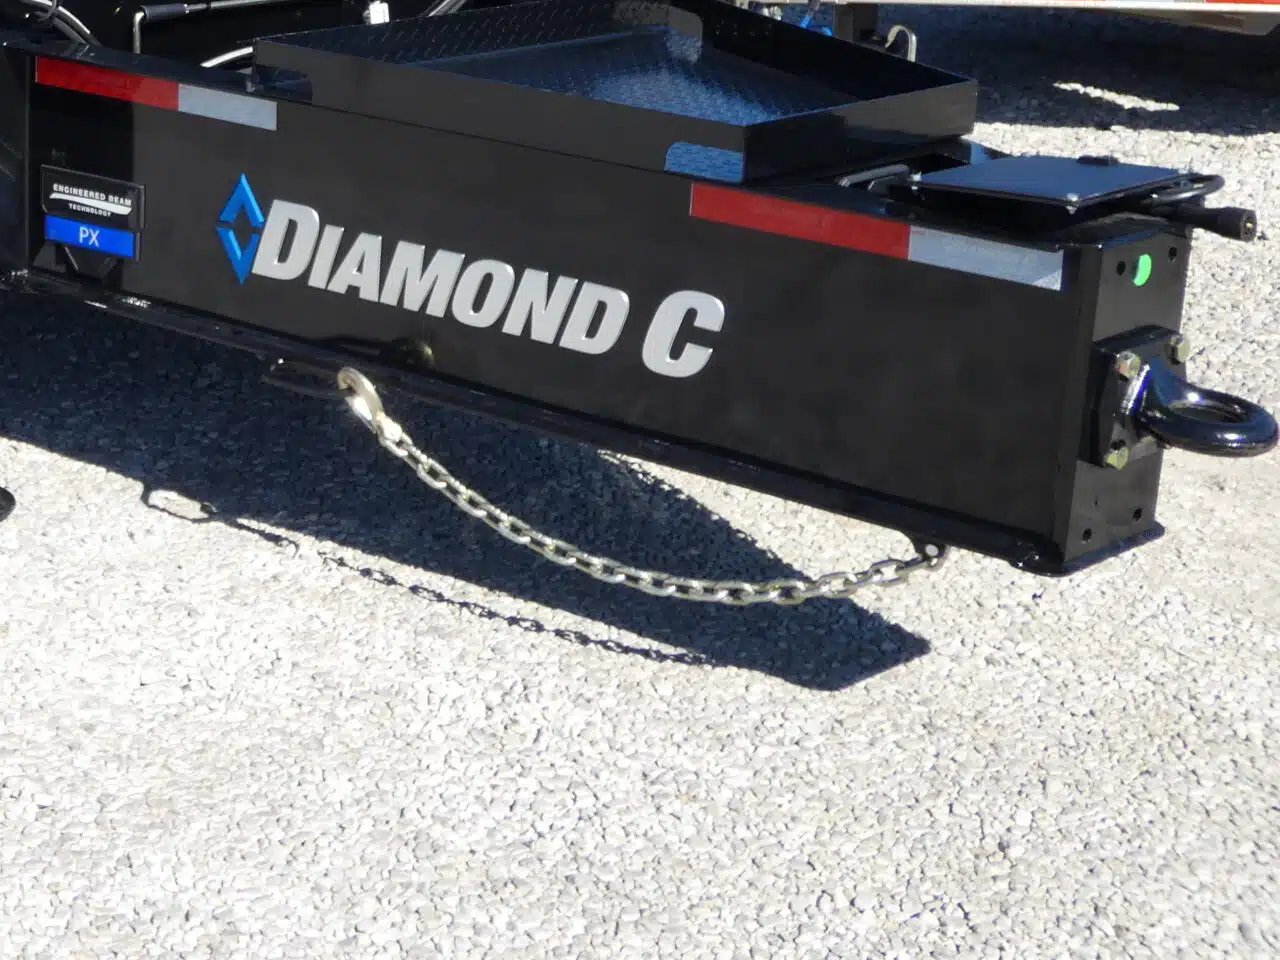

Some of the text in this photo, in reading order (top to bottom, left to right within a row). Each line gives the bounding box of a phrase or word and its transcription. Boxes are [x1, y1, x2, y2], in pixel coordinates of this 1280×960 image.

[53, 183, 132, 206] ENGINEERED BEAM
[68, 203, 111, 217] TECHNOLOGY
[79, 226, 101, 248] PX
[251, 199, 726, 379] DIAMOND C
